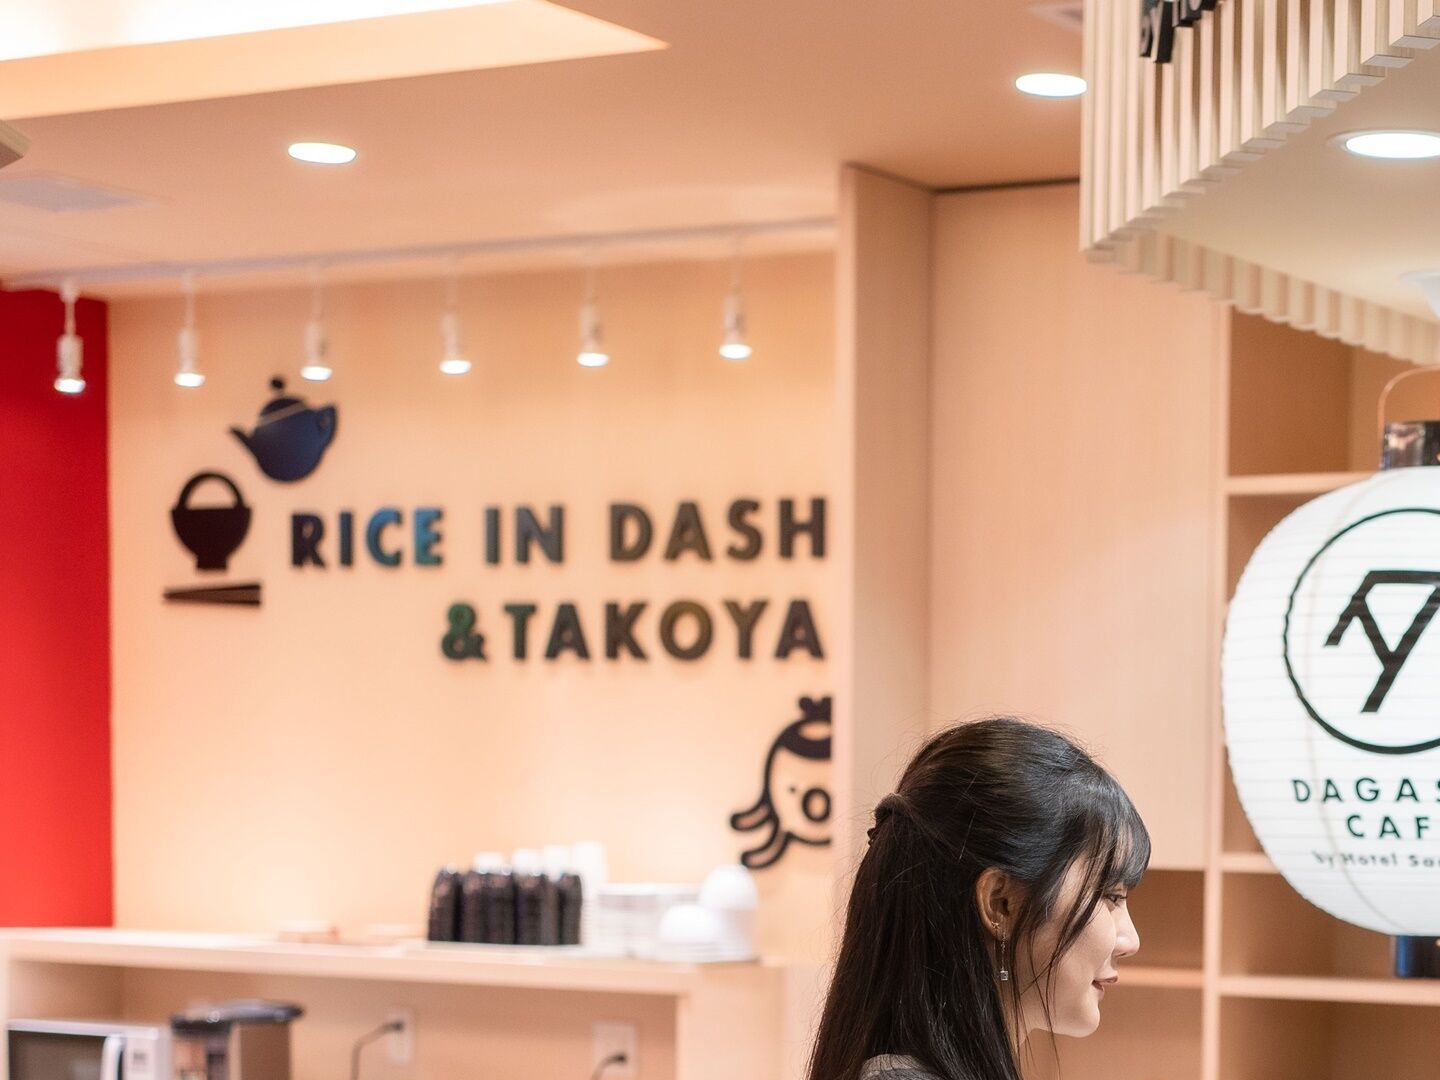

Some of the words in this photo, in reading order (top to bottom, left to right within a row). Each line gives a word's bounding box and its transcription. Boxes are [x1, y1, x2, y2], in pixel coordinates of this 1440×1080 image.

[289, 508, 445, 571] RICE
[484, 505, 566, 567] IN
[608, 496, 829, 565] DASH
[439, 598, 827, 664] &TAKOYA
[1338, 851, 1398, 867] Hotel
